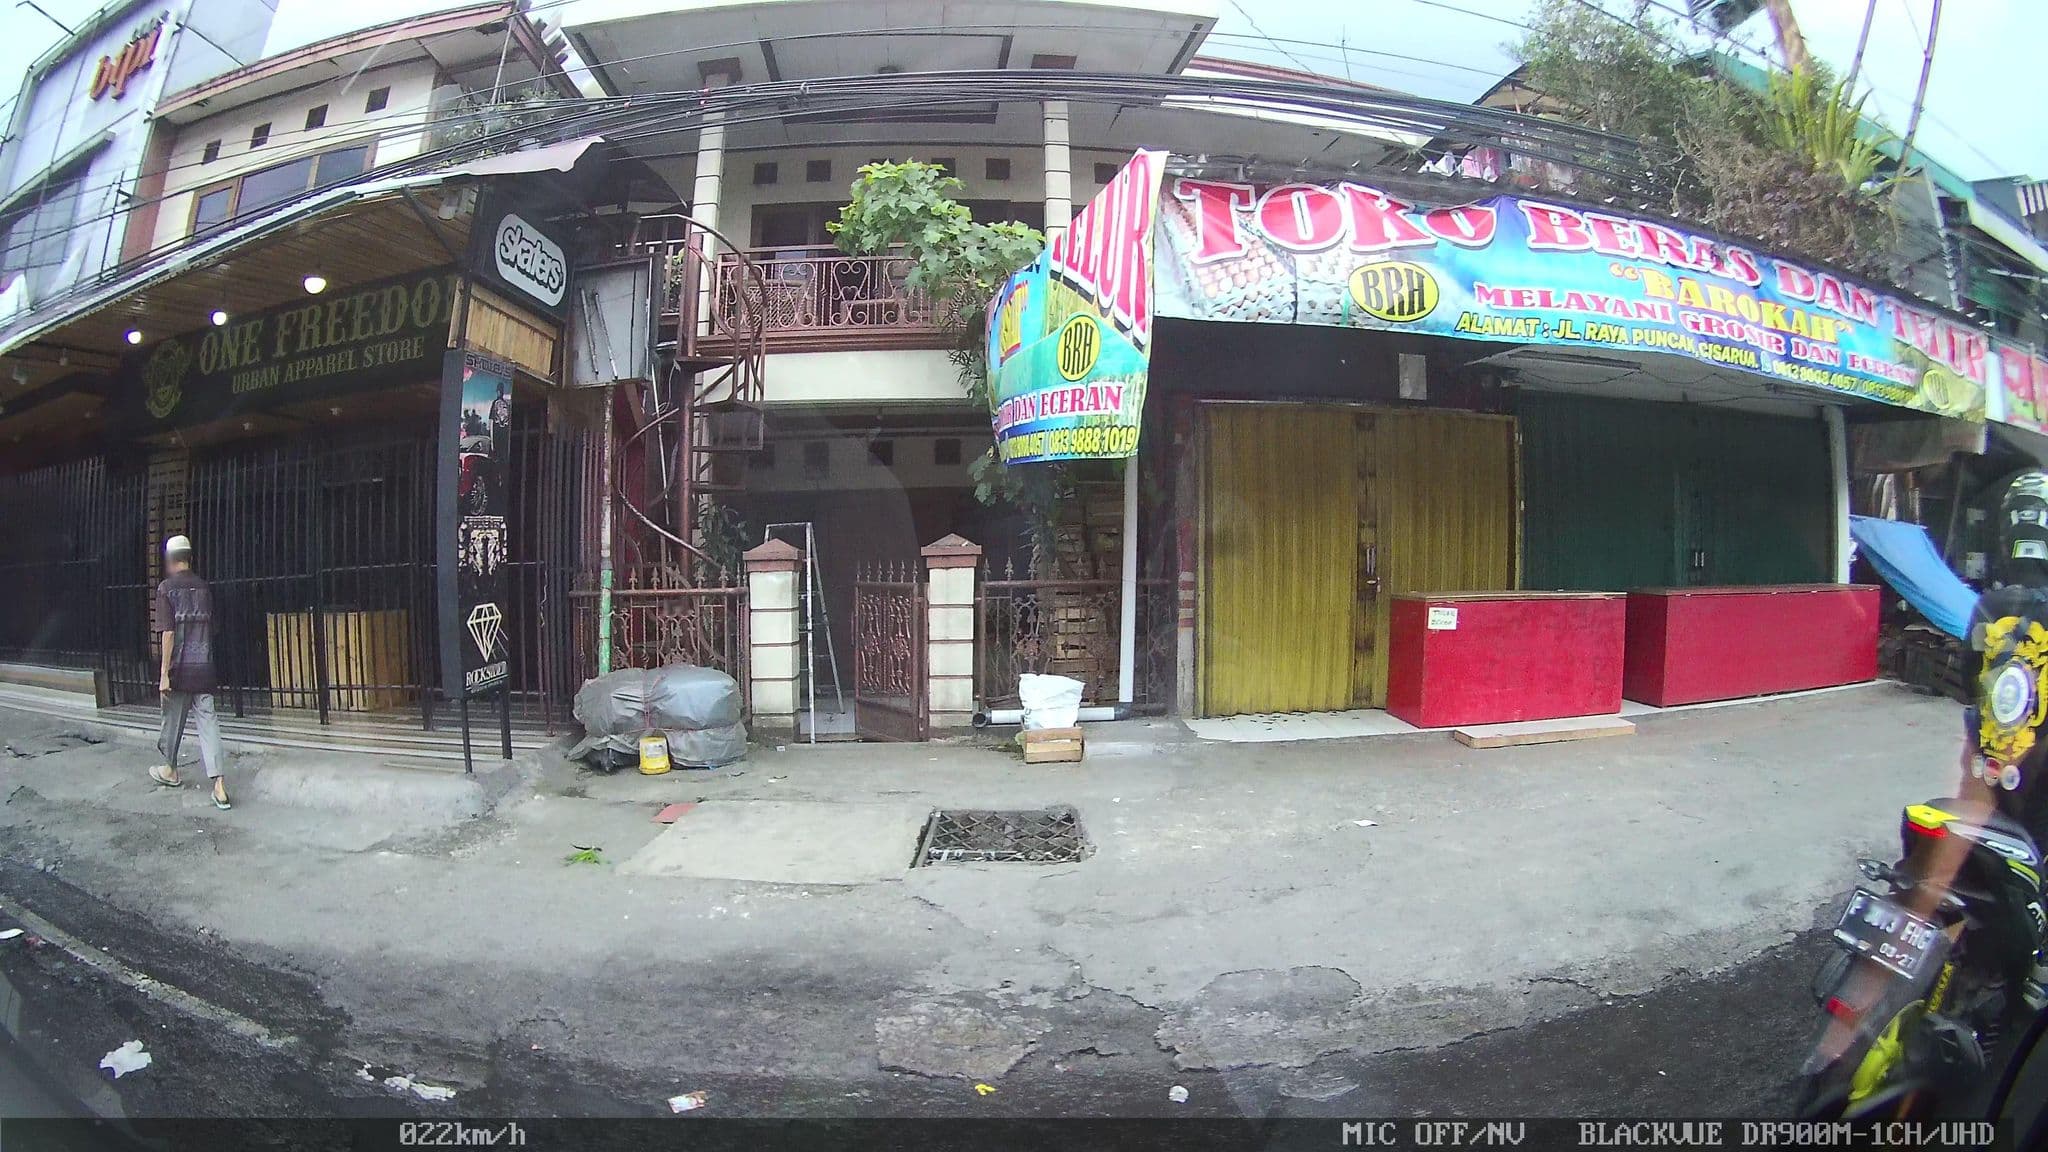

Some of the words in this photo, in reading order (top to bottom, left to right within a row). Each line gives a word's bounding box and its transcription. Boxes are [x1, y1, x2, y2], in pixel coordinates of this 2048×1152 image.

[1174, 178, 1497, 263] TOKO
[1517, 200, 1761, 286] BERAS
[1773, 258, 1878, 326] DAN
[1361, 267, 1426, 316] BRH
[200, 320, 264, 375] ONE
[272, 277, 453, 357] FREEDO
[1064, 322, 1094, 375] BRH
[1476, 285, 1672, 322] MELAYANI
[1792, 339, 1839, 365] DAN
[1553, 319, 1580, 339] JL.
[1585, 323, 1629, 345] RAYA
[232, 366, 279, 393] URBAN
[284, 350, 355, 383] APPAREL
[363, 336, 424, 368] STORE
[1015, 394, 1034, 421] DAN
[1040, 385, 1122, 417] ECERAN
